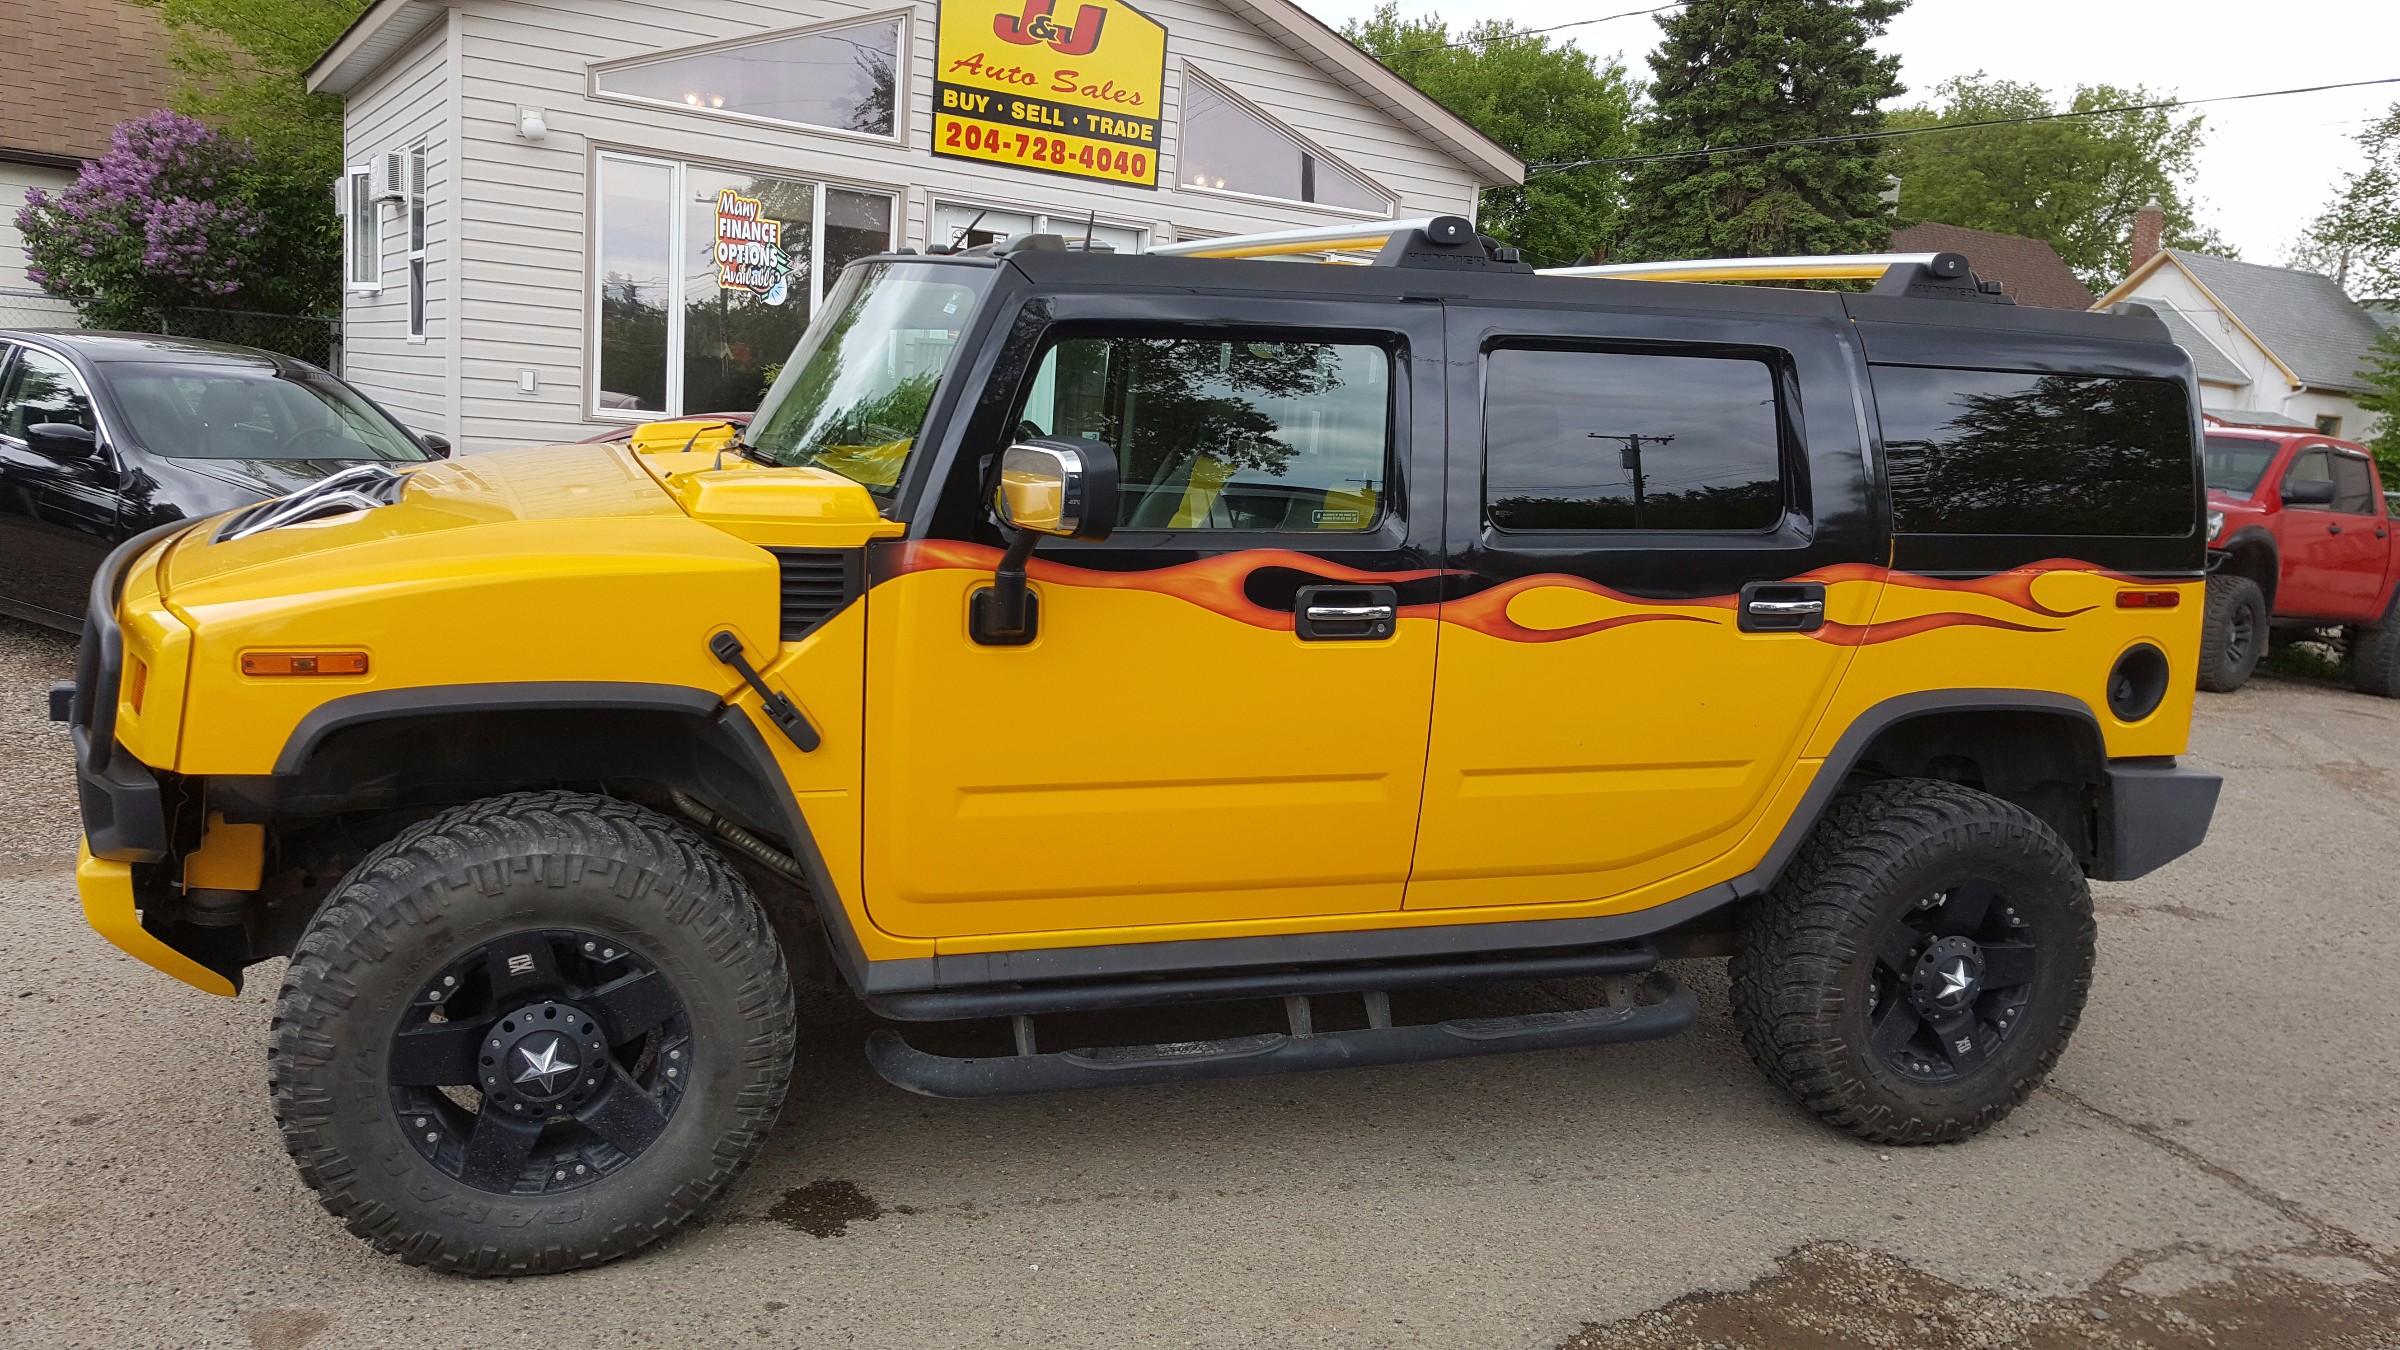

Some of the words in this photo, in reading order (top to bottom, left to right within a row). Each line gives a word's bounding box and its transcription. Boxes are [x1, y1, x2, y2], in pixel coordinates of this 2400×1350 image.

[993, 0, 1108, 55] J&J
[949, 53, 1038, 86] Auto
[1050, 69, 1144, 106] Sales
[943, 89, 990, 113] BUY
[1011, 102, 1065, 127] SELL
[1086, 114, 1153, 142] TRADE
[946, 121, 1147, 178] 204-728-4040
[719, 192, 757, 222] Many
[719, 217, 777, 243] FINANCE
[718, 241, 778, 268] OPTIONS
[1408, 251, 1486, 267] HUMMER
